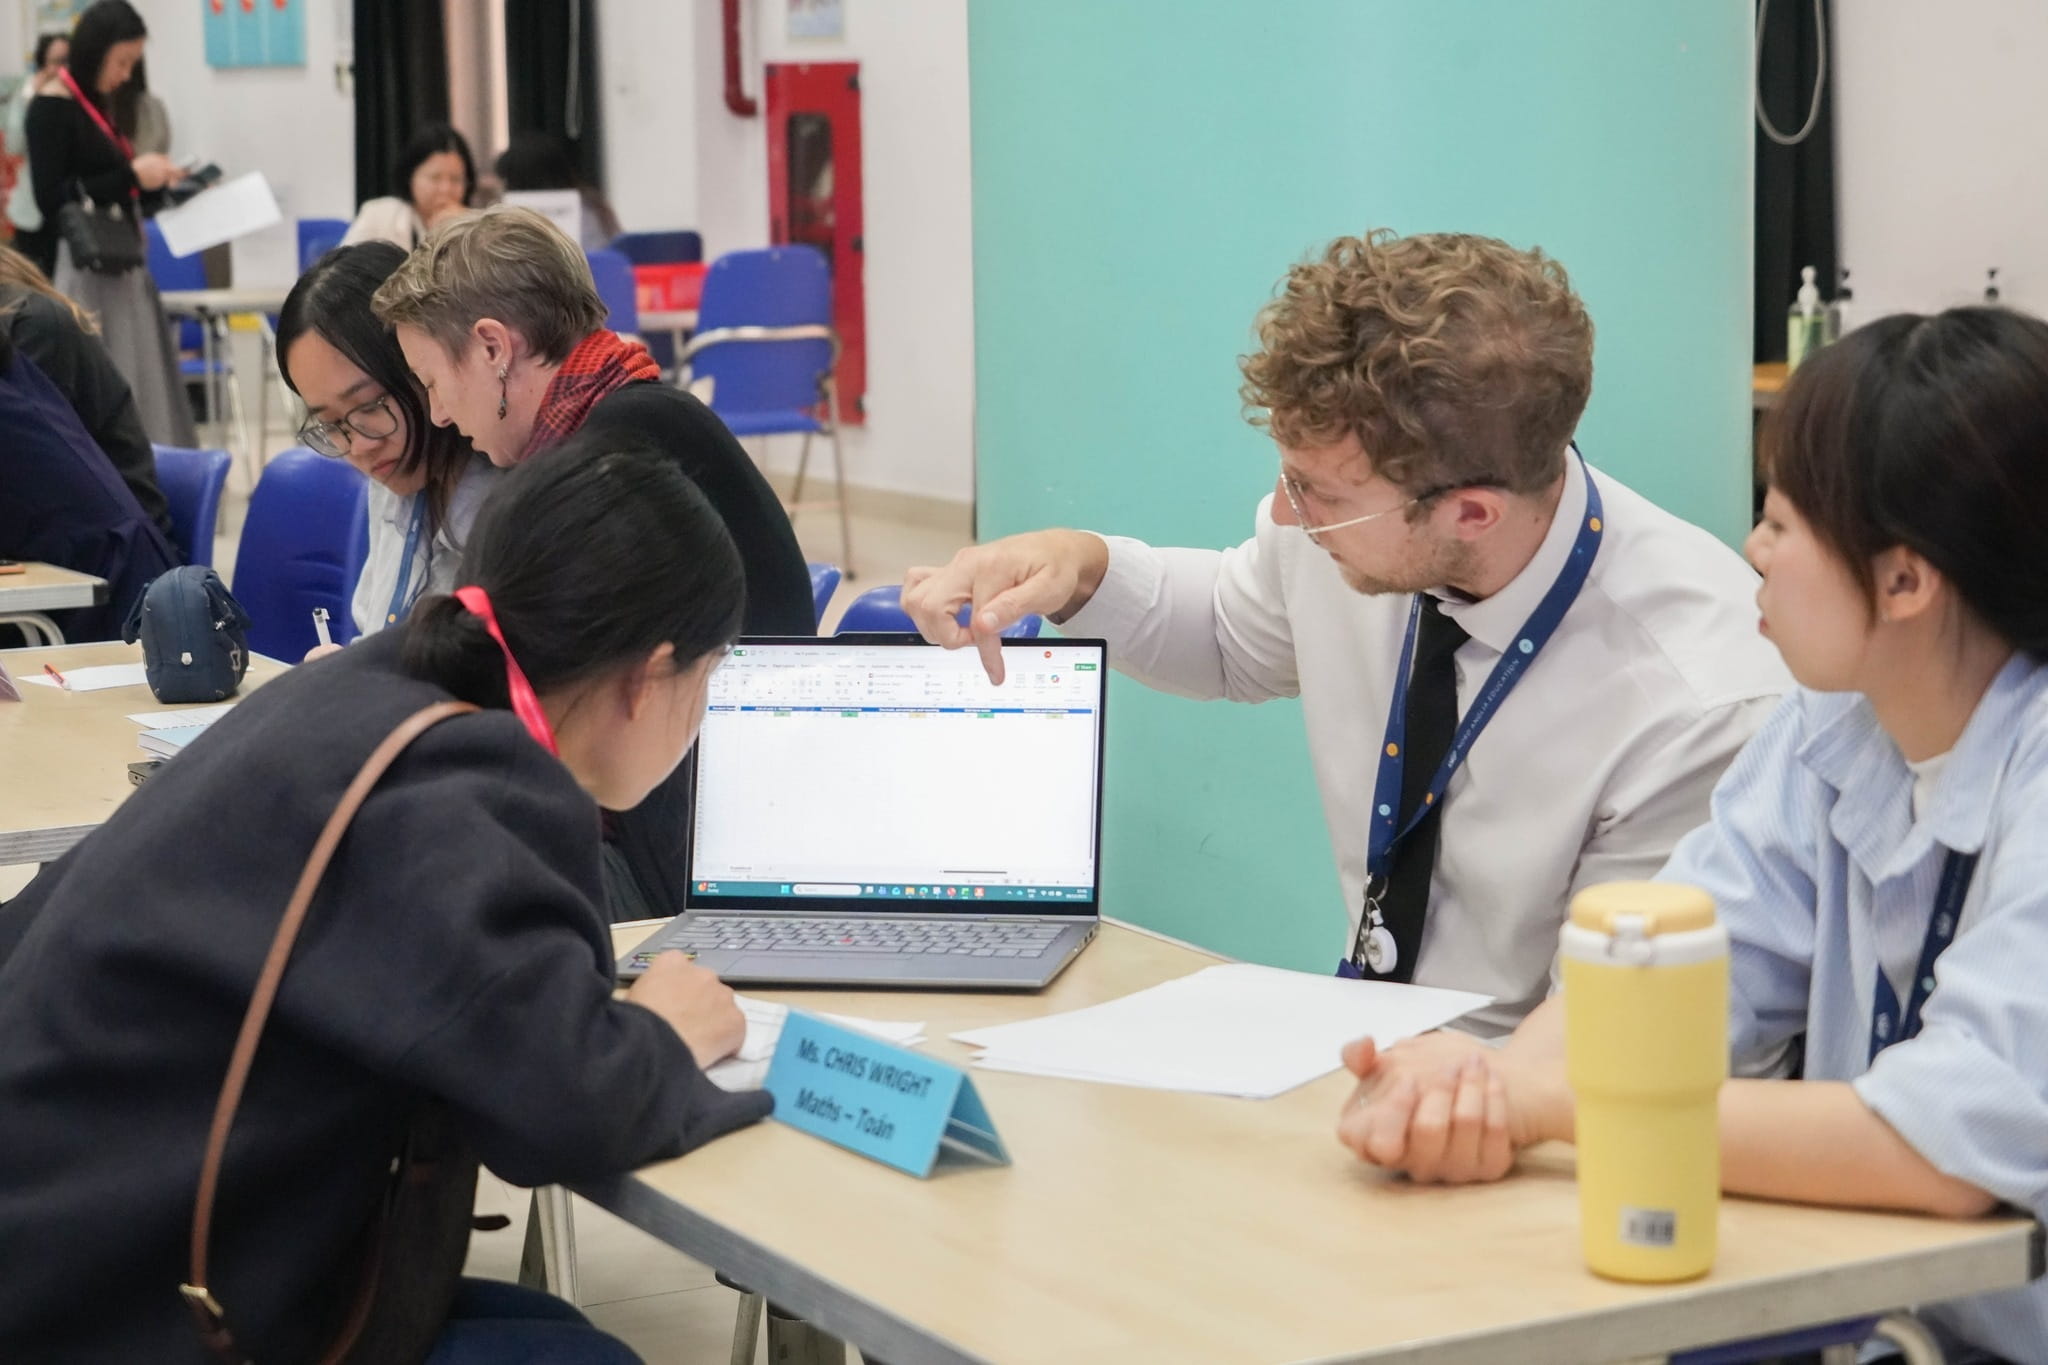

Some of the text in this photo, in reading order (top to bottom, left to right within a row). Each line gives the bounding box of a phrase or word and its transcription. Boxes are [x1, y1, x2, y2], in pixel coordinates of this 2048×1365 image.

[1487, 658, 1520, 702] EDUCATION
[798, 1037, 933, 1098] Ms. CHRIS WRIGHT
[794, 1087, 841, 1123] Maths
[856, 1107, 896, 1140] Toán
